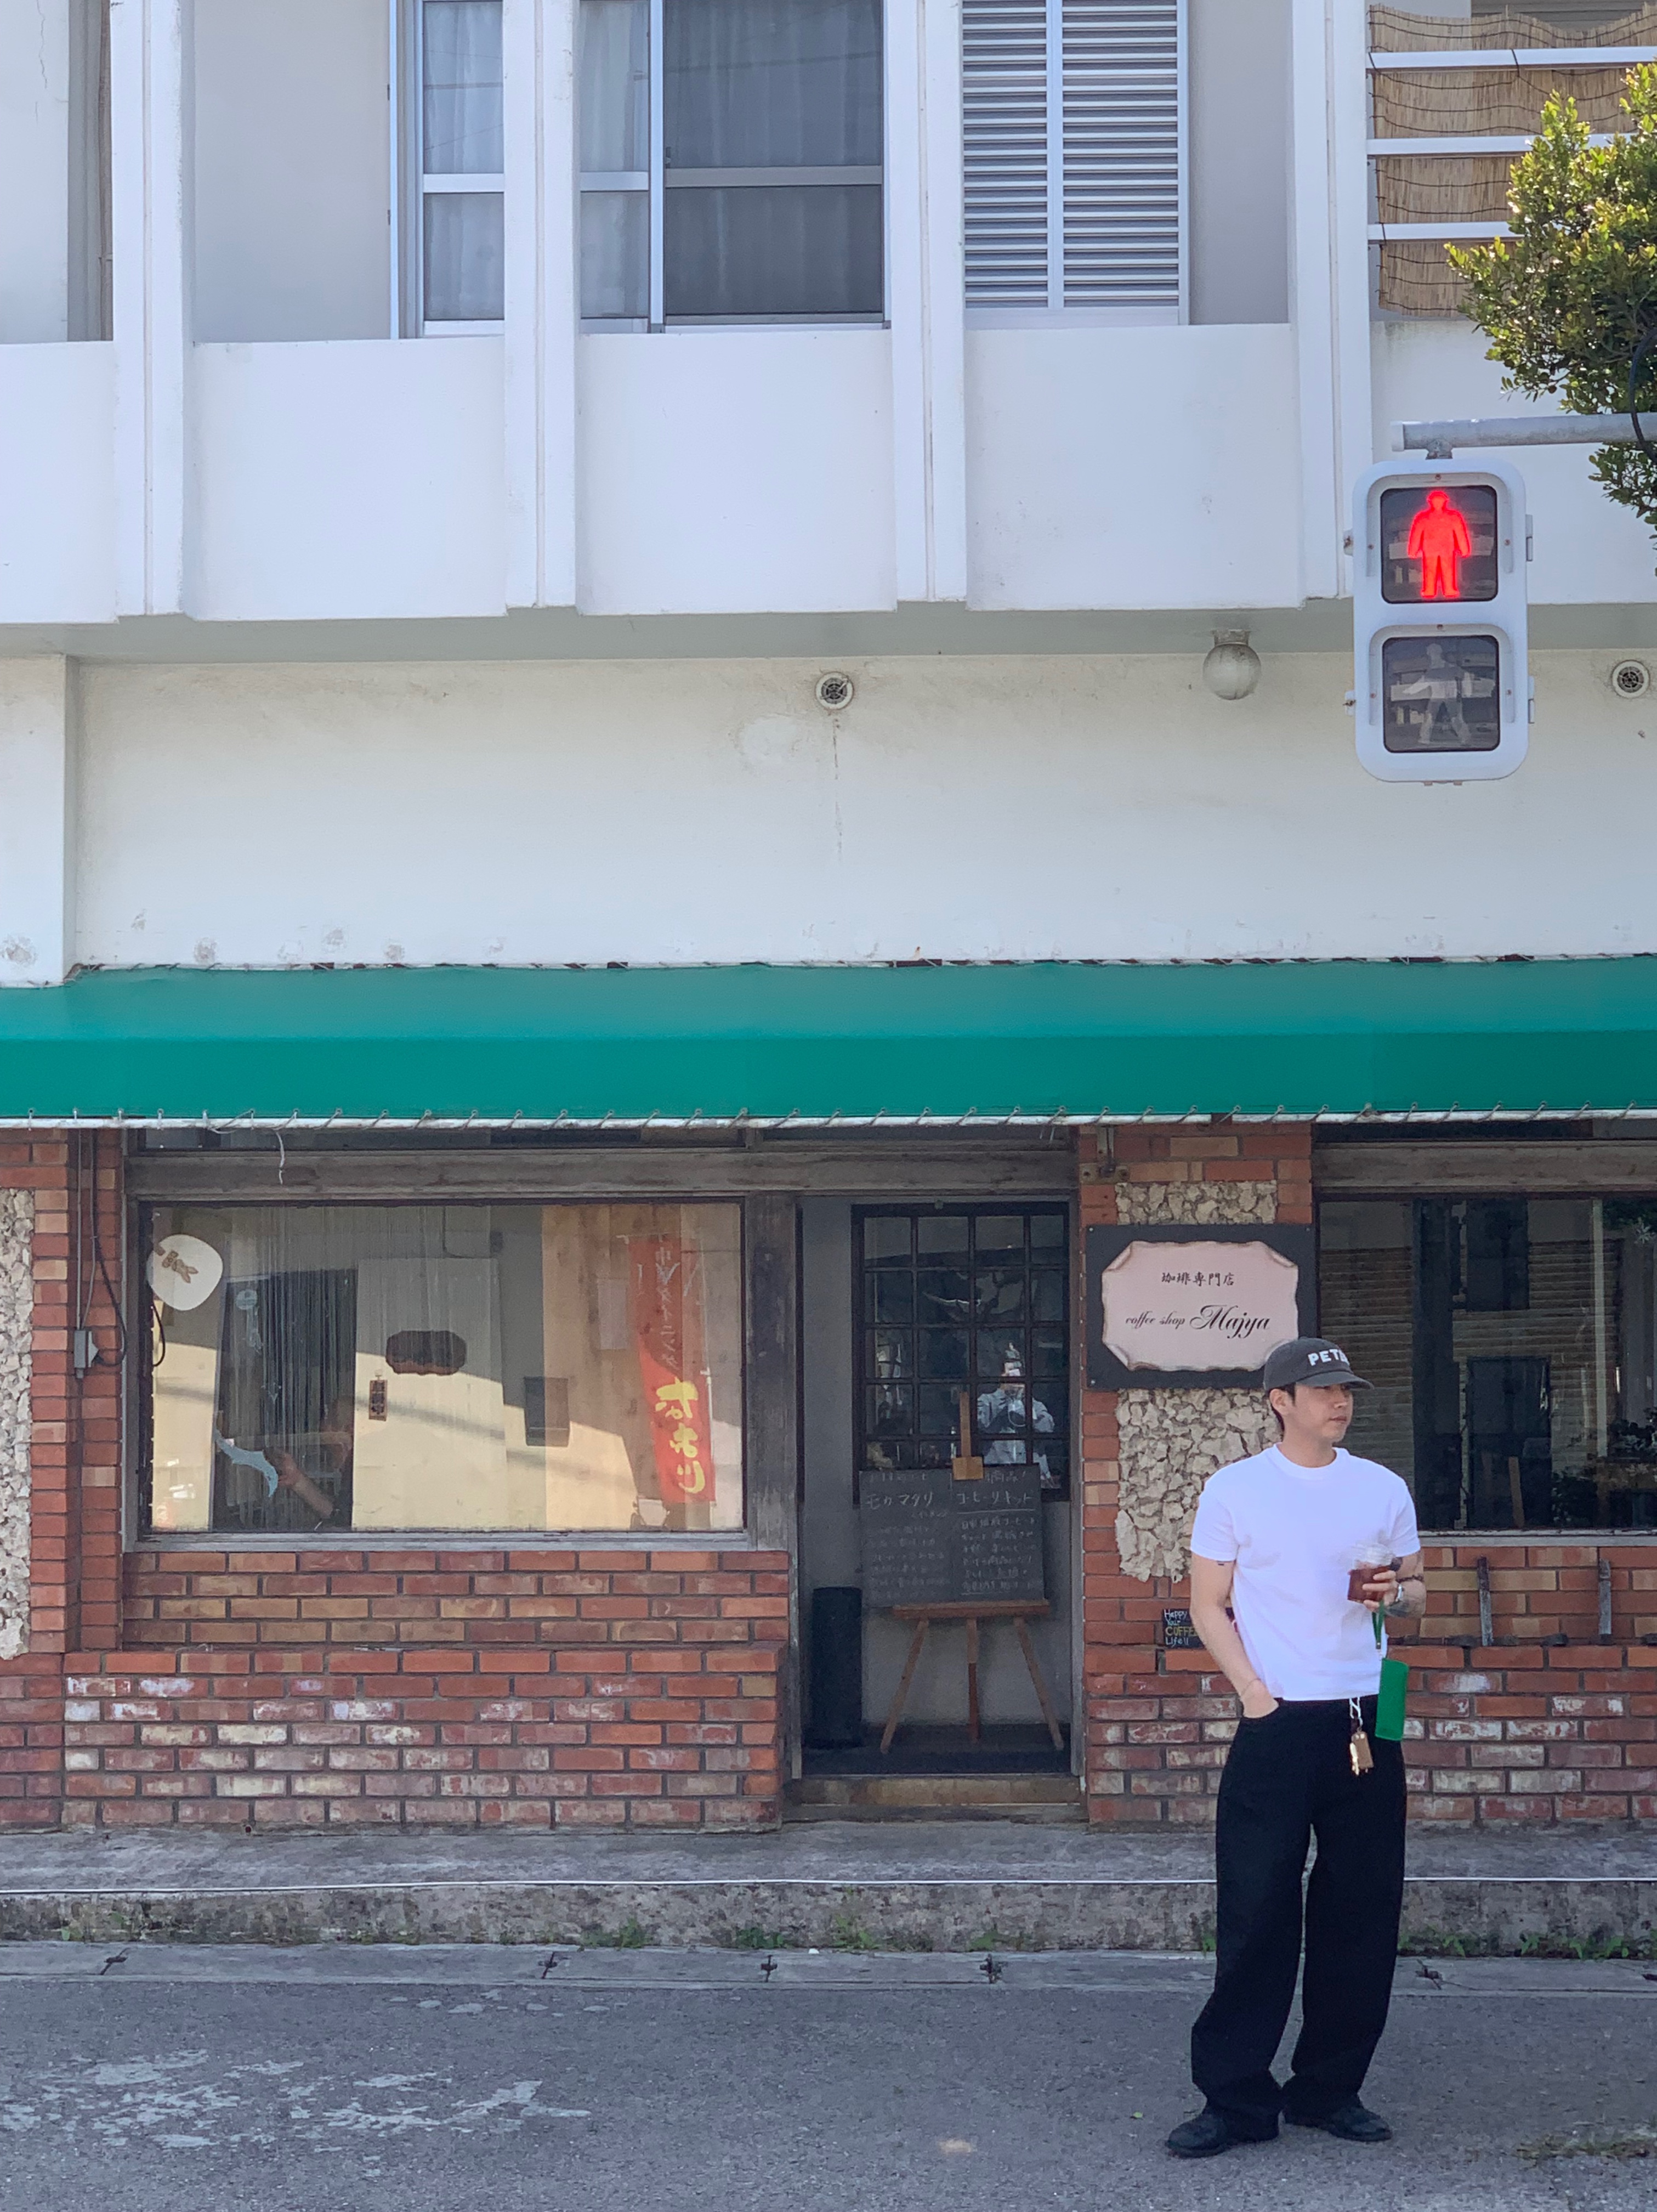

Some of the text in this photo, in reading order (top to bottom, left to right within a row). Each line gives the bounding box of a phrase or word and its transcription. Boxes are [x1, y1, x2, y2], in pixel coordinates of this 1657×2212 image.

[1161, 1272, 1235, 1287] 珈琲専門店
[1125, 1304, 1271, 1339] coffee shop Majya
[1164, 1609, 1188, 1620] Happy
